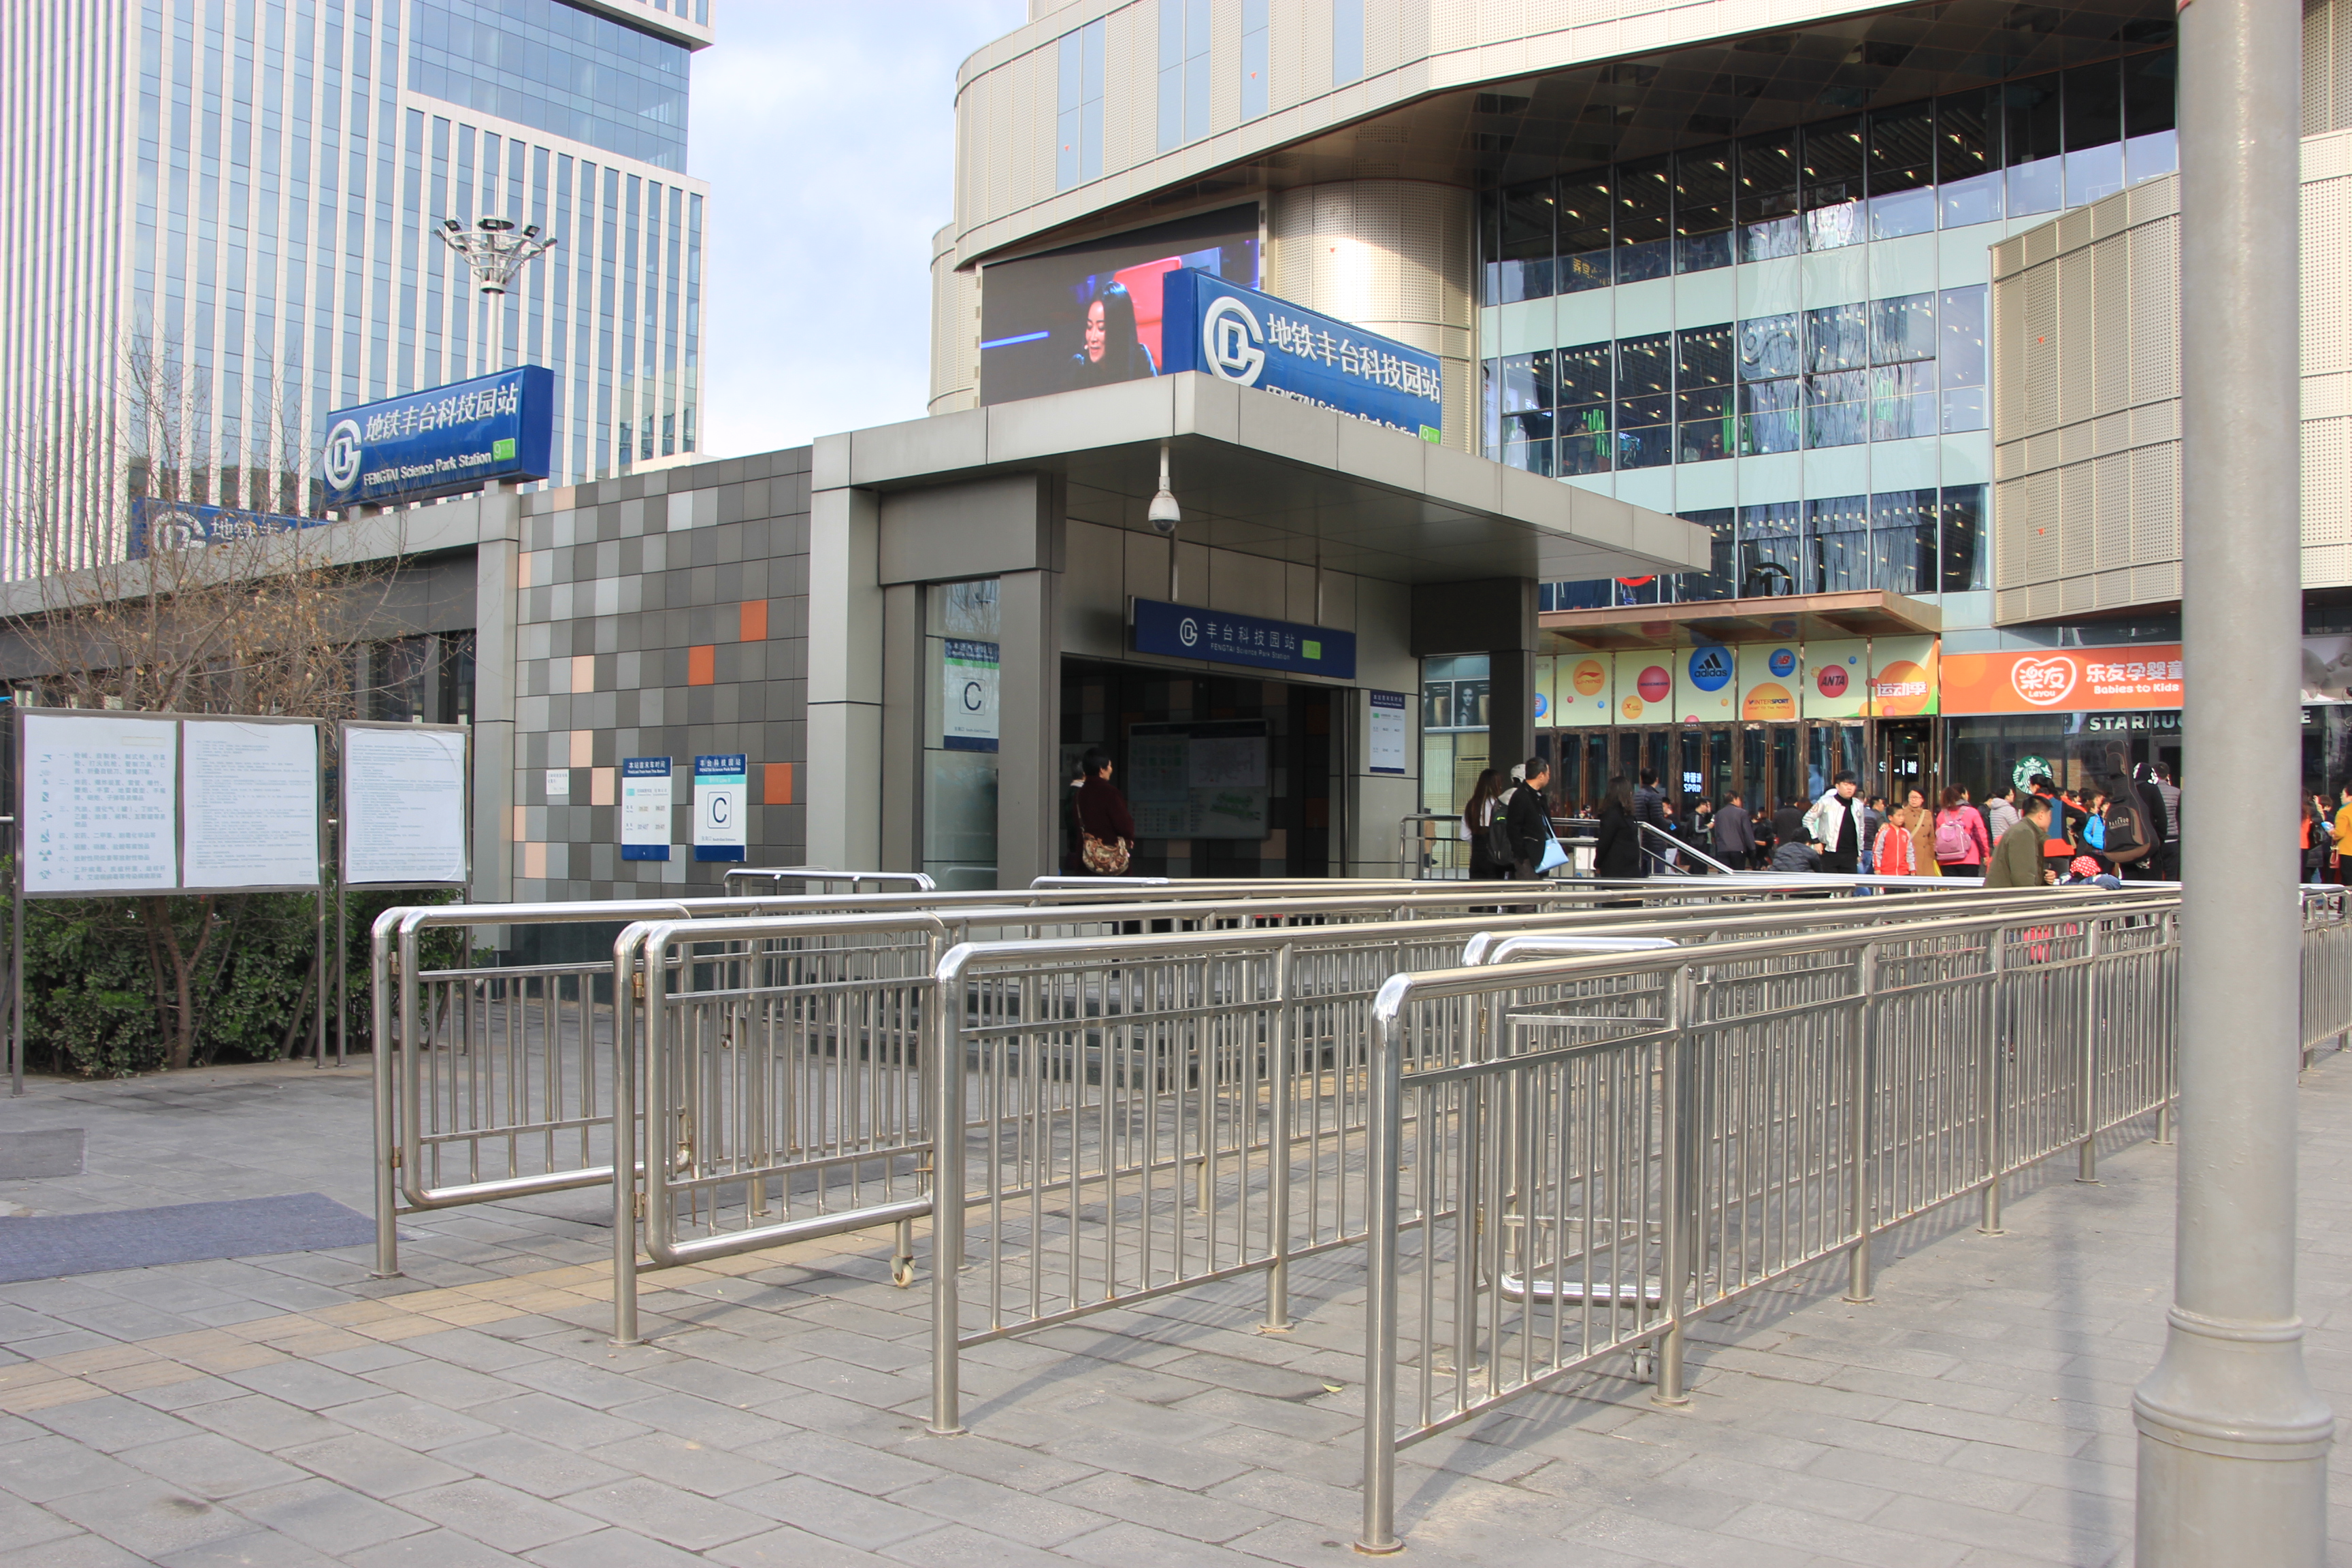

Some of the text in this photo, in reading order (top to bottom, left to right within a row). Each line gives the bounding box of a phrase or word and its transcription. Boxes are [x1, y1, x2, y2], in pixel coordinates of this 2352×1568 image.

[1267, 313, 1440, 404] 地铁丰台科技园站
[364, 382, 519, 442] 地铁丰台科技园站
[363, 452, 492, 486] FENGTAI Science Park Station
[1206, 621, 1295, 650] 丰台科技园站
[1210, 643, 1290, 660] FENGTAI Science Park Station
[1694, 668, 1727, 677] adidas
[1820, 676, 1846, 687] ANTA
[964, 681, 981, 710] C
[1876, 681, 1927, 697] 运动季
[2094, 683, 2179, 694] Babies to Kids
[700, 758, 741, 767] 丰台科技园站
[713, 797, 727, 823] C
